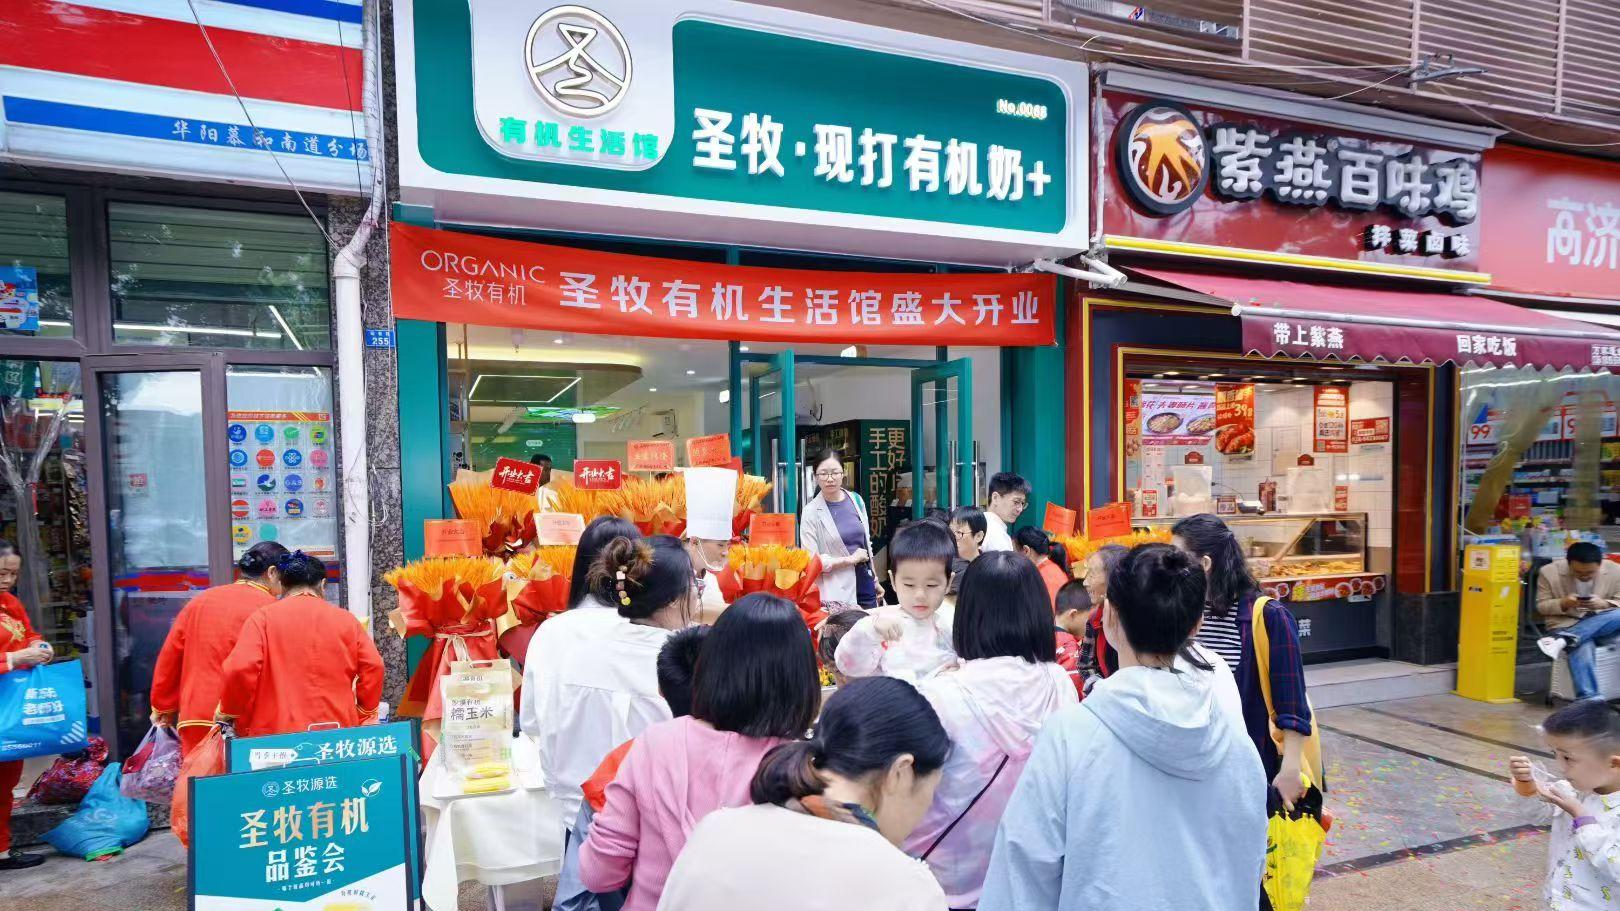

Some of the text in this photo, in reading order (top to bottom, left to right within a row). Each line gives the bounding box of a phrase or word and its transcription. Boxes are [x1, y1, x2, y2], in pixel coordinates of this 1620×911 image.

[500, 117, 660, 160] 有机生活馆
[1212, 127, 1478, 218] 紫燕百味鸡
[421, 249, 545, 284] ORGANIC
[443, 278, 527, 306] 圣牧有机
[559, 271, 1040, 327] 圣牧有机生活馆盛大开业
[372, 337, 389, 346] 255
[1273, 322, 1344, 350] 带上紫燕
[1456, 334, 1517, 357] 回家吃饭
[450, 704, 494, 721] 糯玉米
[315, 735, 398, 761] 圣牧源选
[282, 775, 339, 796] 圣牧源选
[239, 797, 370, 850] 圣牧有机
[265, 842, 345, 884] 品鉴会
